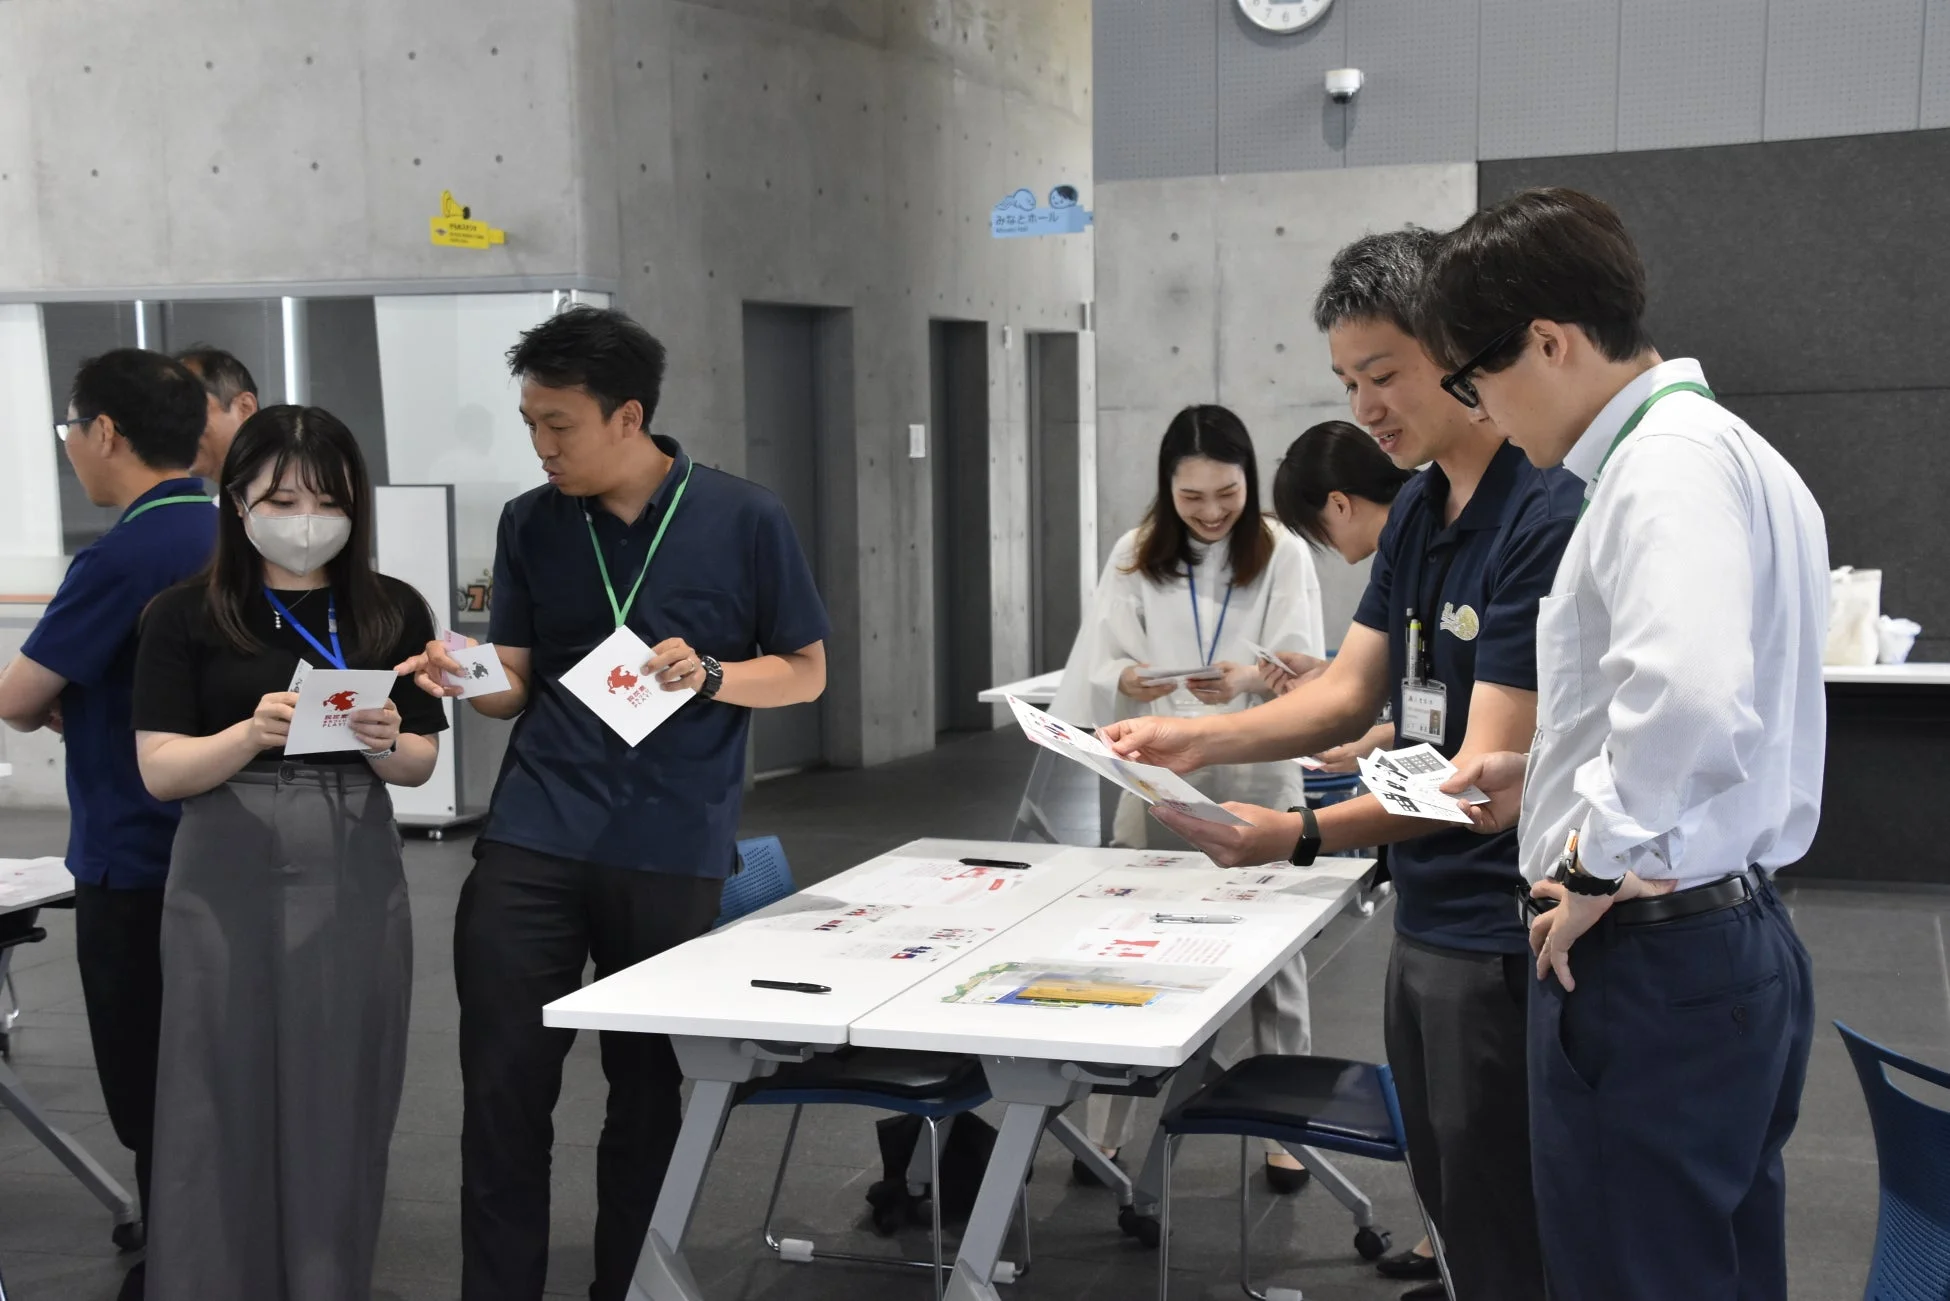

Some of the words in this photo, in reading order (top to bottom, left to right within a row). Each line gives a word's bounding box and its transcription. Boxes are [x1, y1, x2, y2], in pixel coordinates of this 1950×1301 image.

[1281, 11, 1290, 23] 6
[995, 212, 1060, 225] みなとホール
